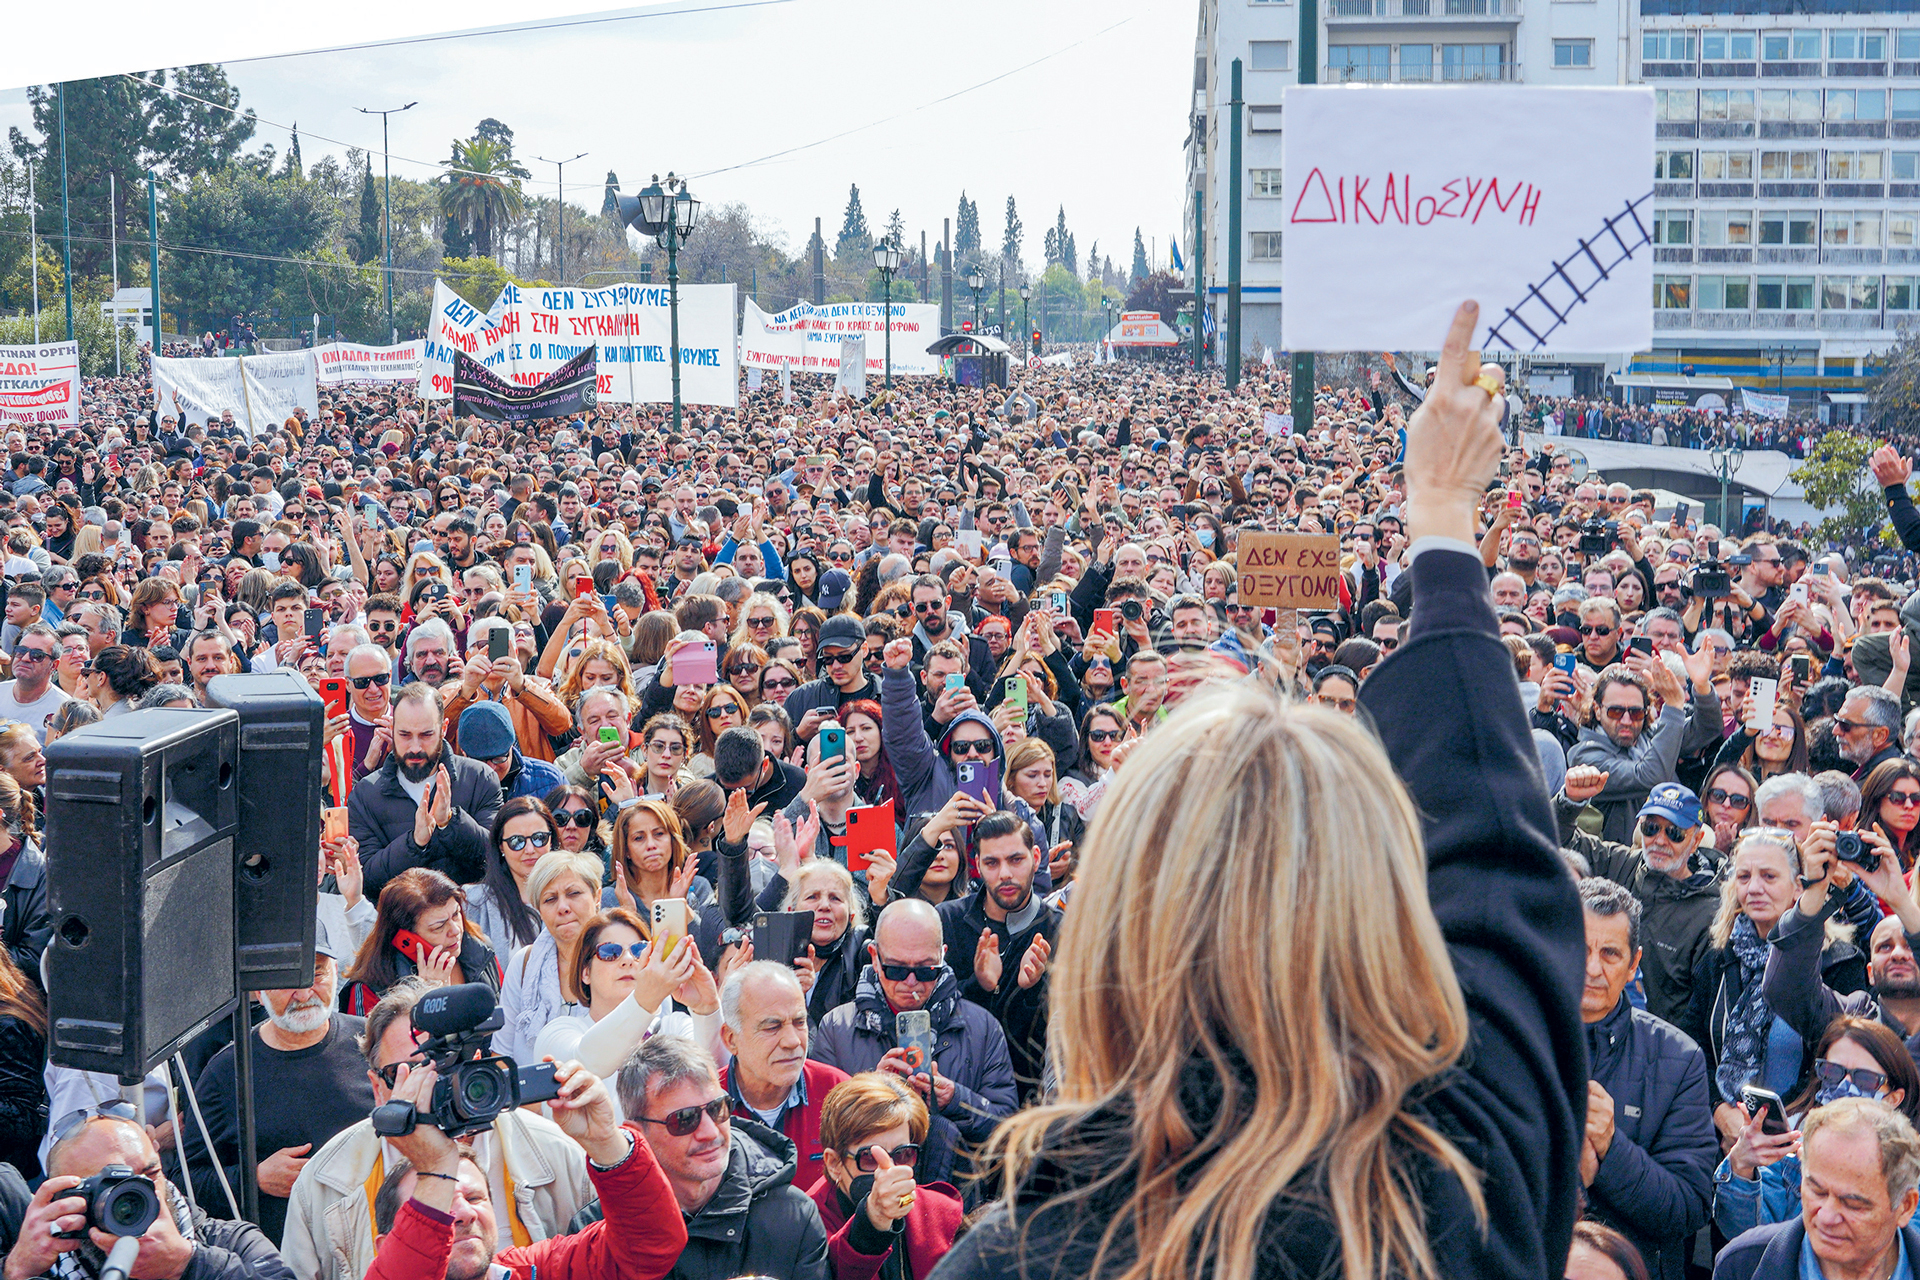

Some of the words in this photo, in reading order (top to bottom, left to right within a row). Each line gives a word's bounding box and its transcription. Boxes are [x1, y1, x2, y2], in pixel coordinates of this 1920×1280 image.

[1291, 167, 1542, 227] ΔΙΚΑΙΟΣΥΝΗ
[542, 290, 574, 310] ΔΕΝ
[443, 298, 479, 328] ΔΕΝ
[774, 313, 788, 324] ΝΑ
[831, 306, 850, 317] ΔΕΝ
[531, 312, 559, 335] ΣΤΗ
[836, 321, 845, 331] ΤΟ
[874, 321, 920, 332] ΔΟΟΦΟΝΟ
[39, 346, 77, 358] ΟΡΓΗ
[322, 350, 340, 364] ΟΧΙ
[342, 349, 370, 361] ΑΛΛΑ
[373, 348, 415, 361] ΤΕΜΠΗ!
[530, 343, 542, 360] ΟΙ
[669, 347, 720, 366] ΘΥΝΕΣ
[1245, 548, 1288, 567] ΔΕΝ
[1242, 573, 1338, 598] ΟΞΥΓΟΝΟ
